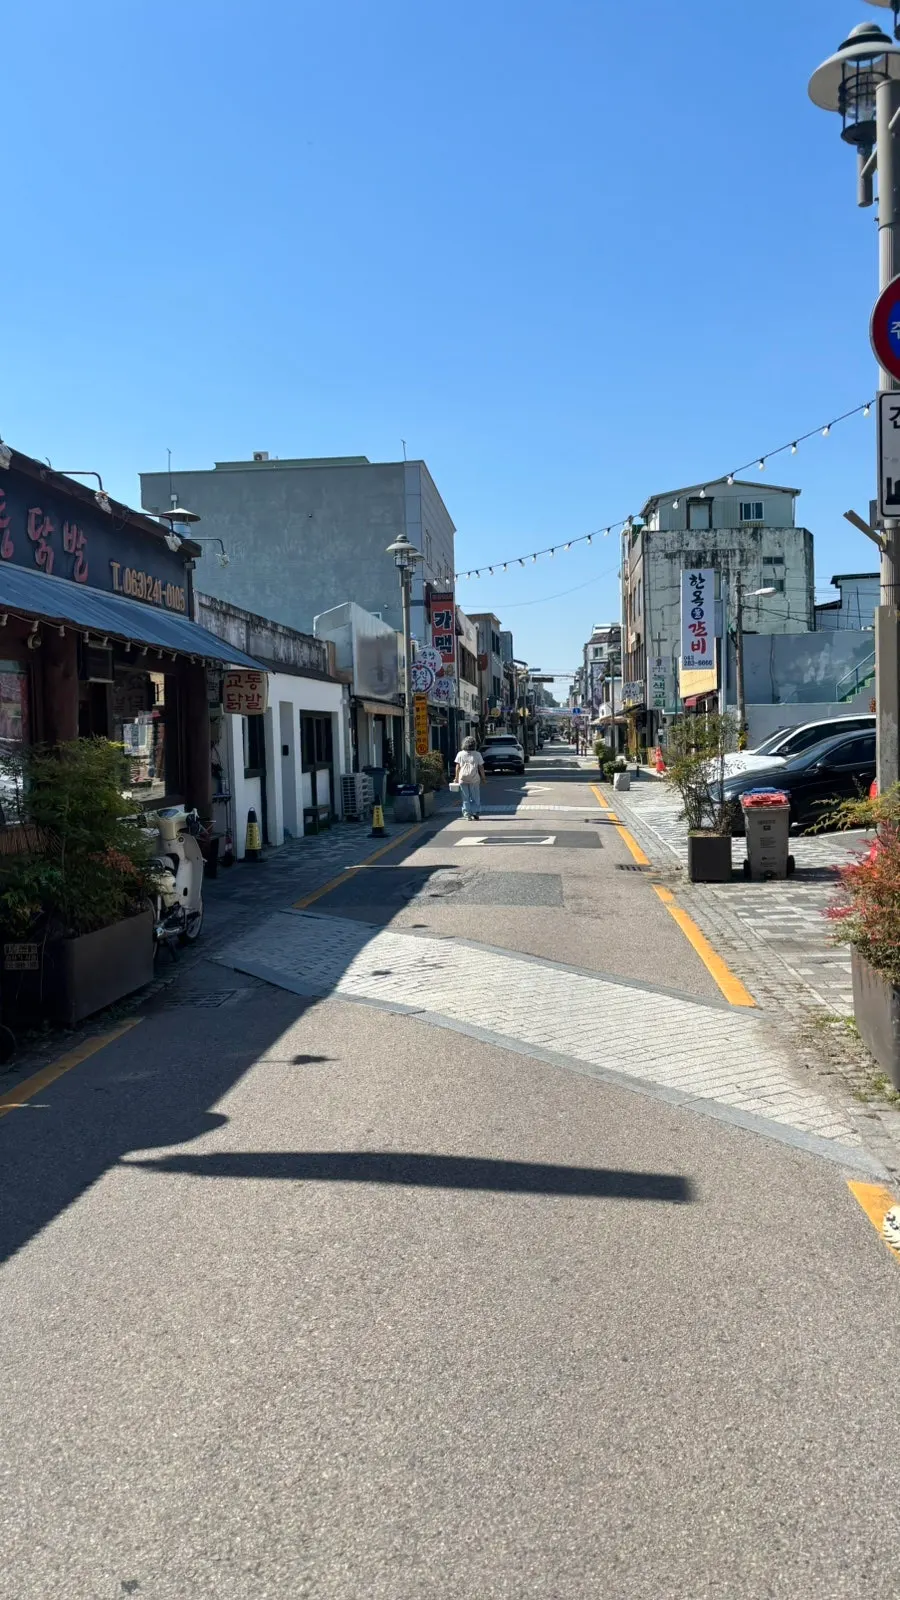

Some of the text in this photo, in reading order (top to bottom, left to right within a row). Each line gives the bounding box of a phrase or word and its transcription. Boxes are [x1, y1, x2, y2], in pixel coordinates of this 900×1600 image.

[688, 621, 708, 655] 갈비
[226, 673, 262, 690] 교동
[226, 693, 262, 710] 닭발
